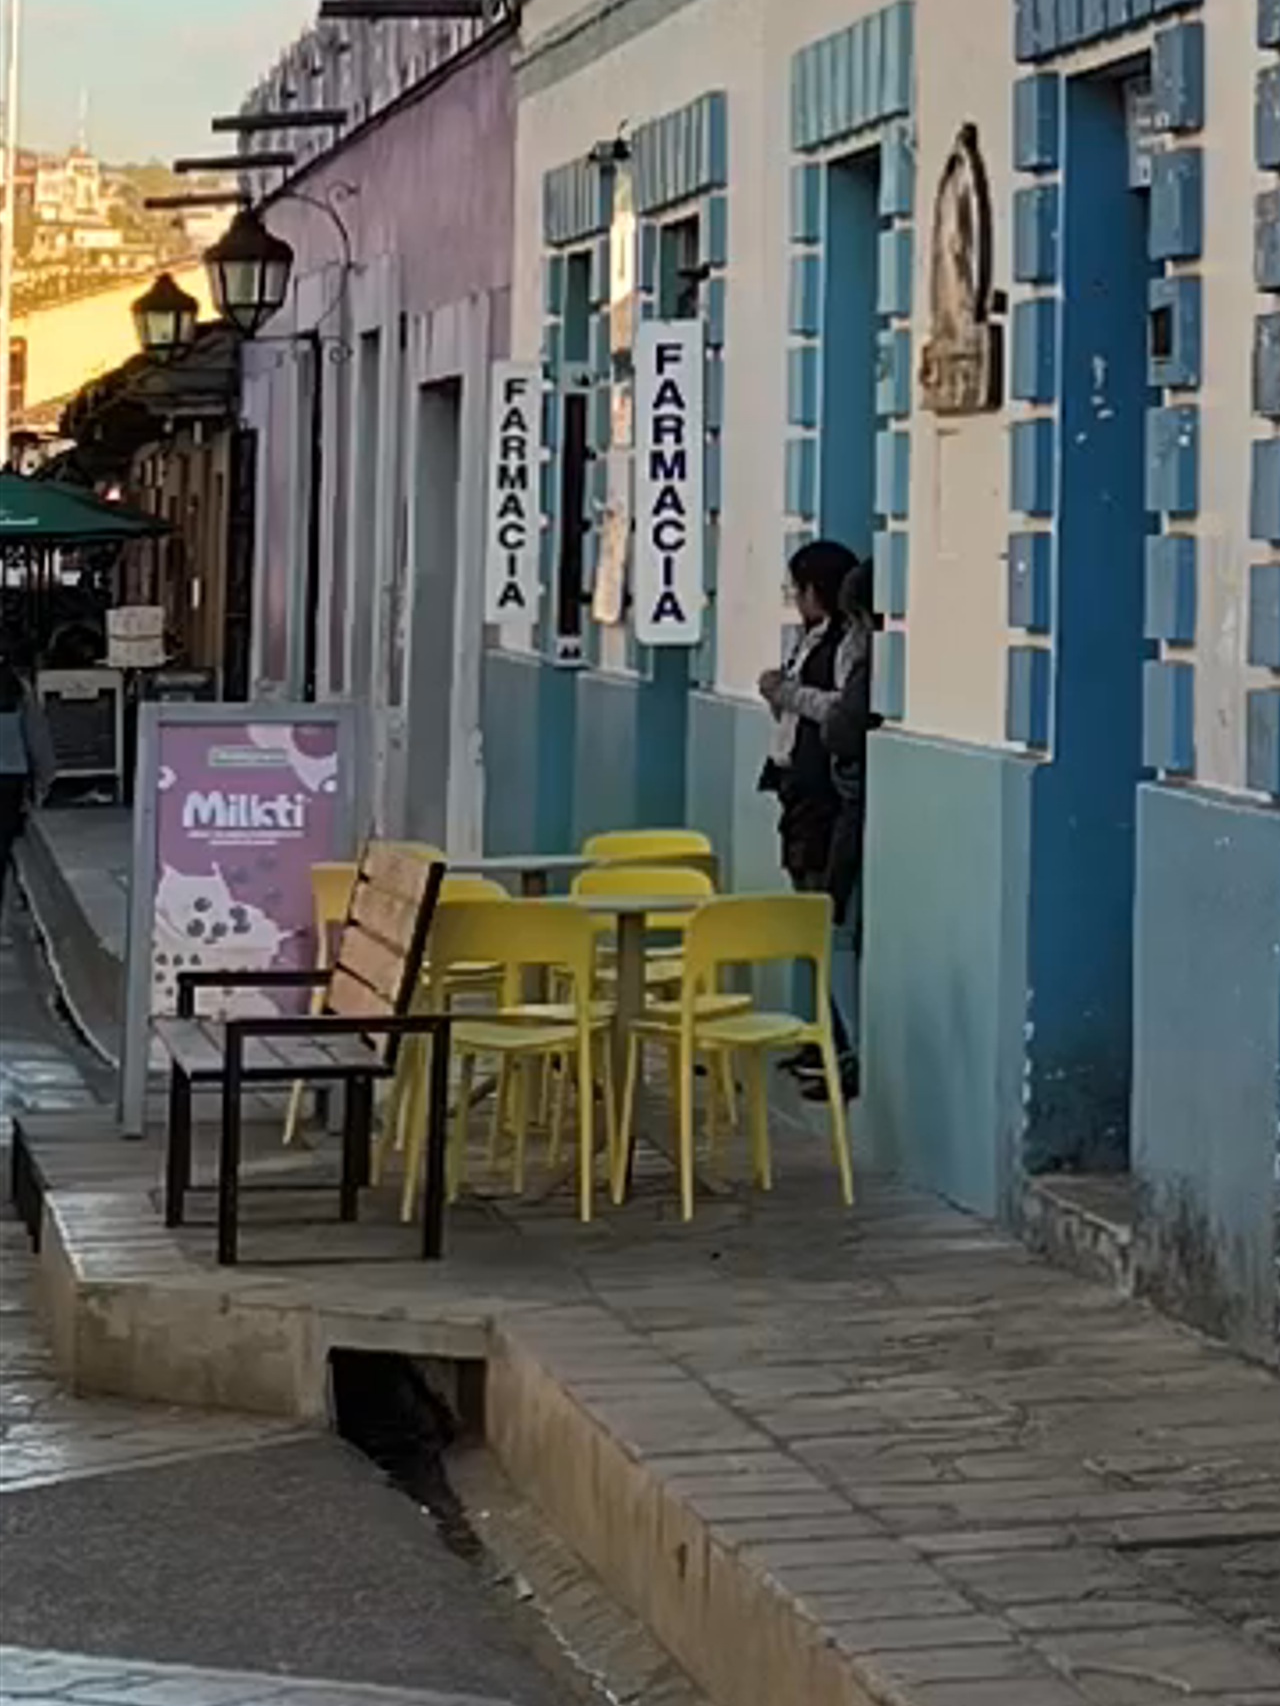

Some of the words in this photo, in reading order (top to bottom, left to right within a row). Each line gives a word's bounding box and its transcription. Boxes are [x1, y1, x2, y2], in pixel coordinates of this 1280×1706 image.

[498, 378, 528, 607] FARMACIA
[650, 343, 686, 623] FARMACIA
[182, 790, 305, 828] Milkti
